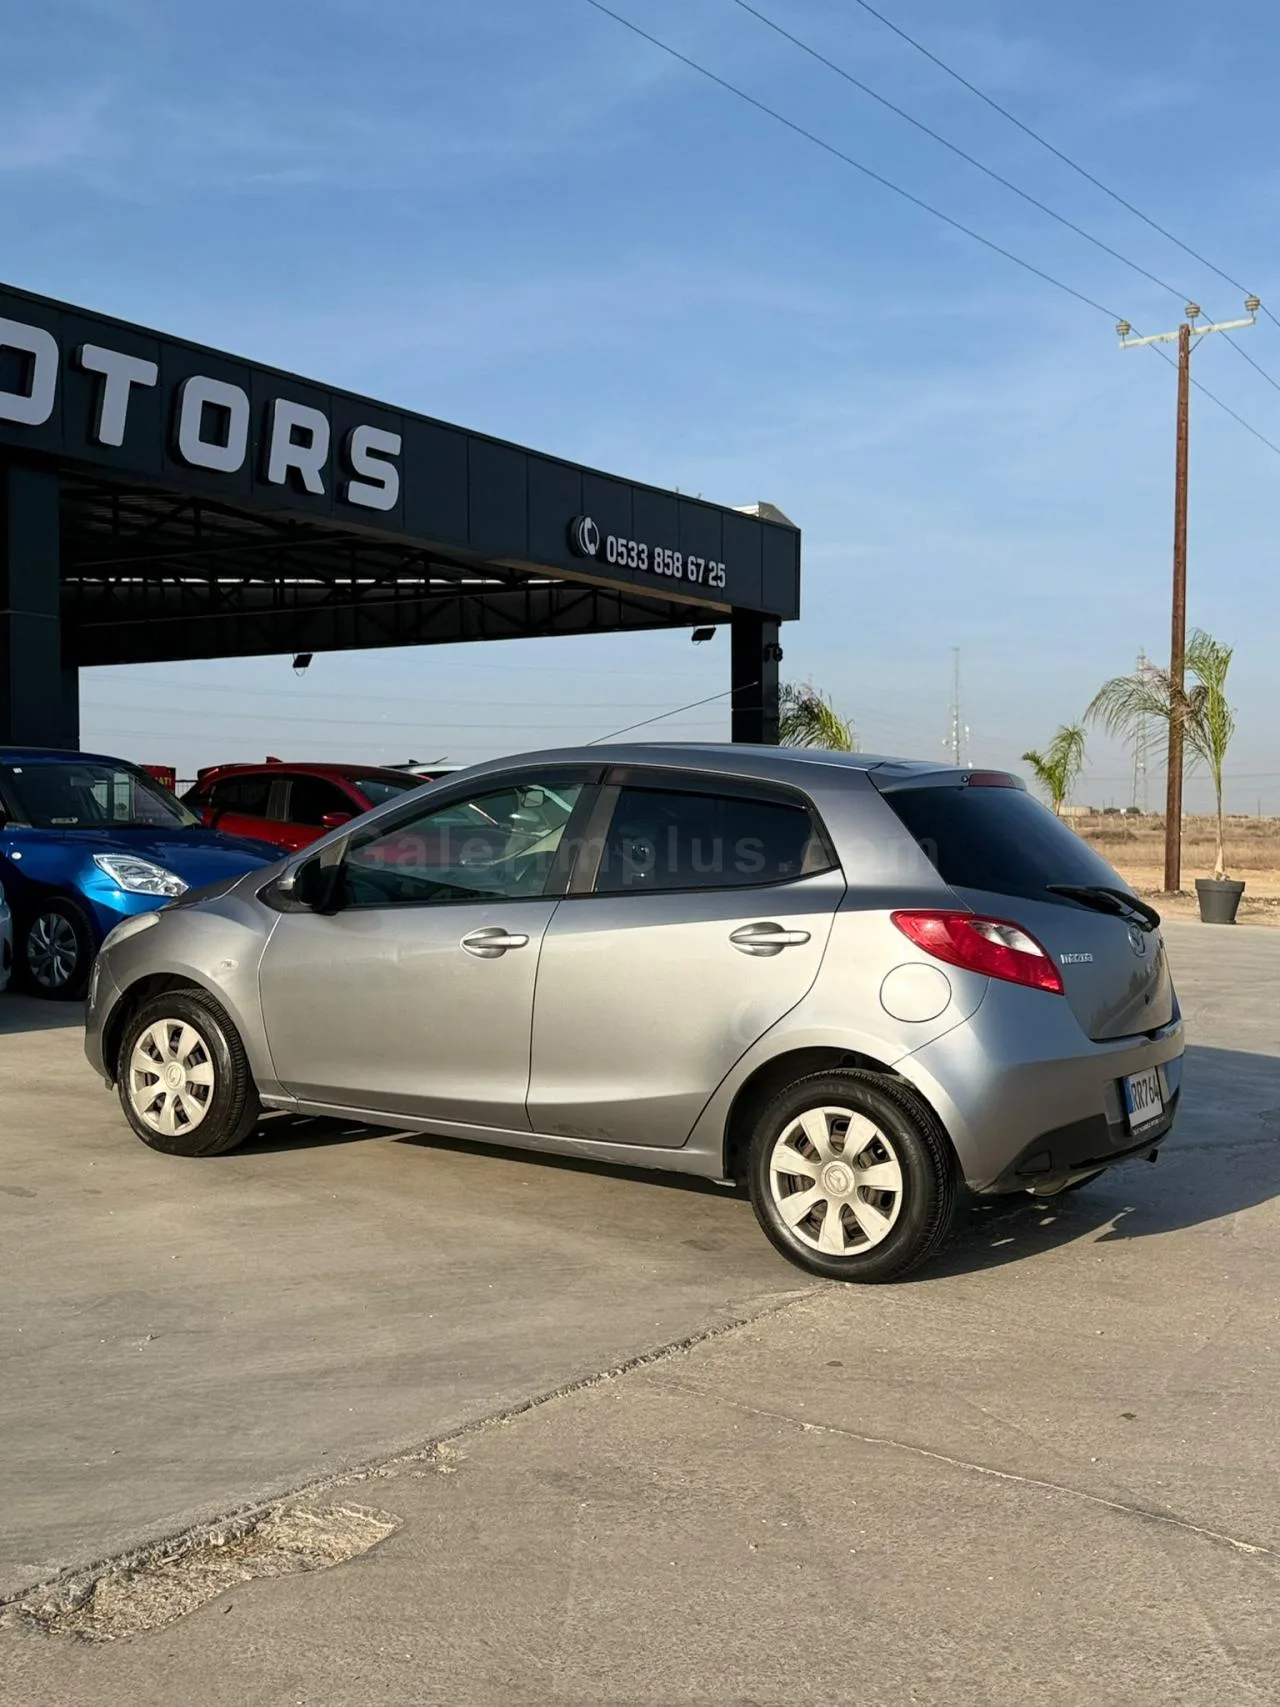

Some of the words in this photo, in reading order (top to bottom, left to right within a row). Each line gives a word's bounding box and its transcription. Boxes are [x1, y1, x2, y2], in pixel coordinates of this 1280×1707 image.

[607, 536, 648, 570] 0533
[654, 548, 683, 578] 858
[687, 555, 705, 584] 67
[708, 560, 726, 588] 25
